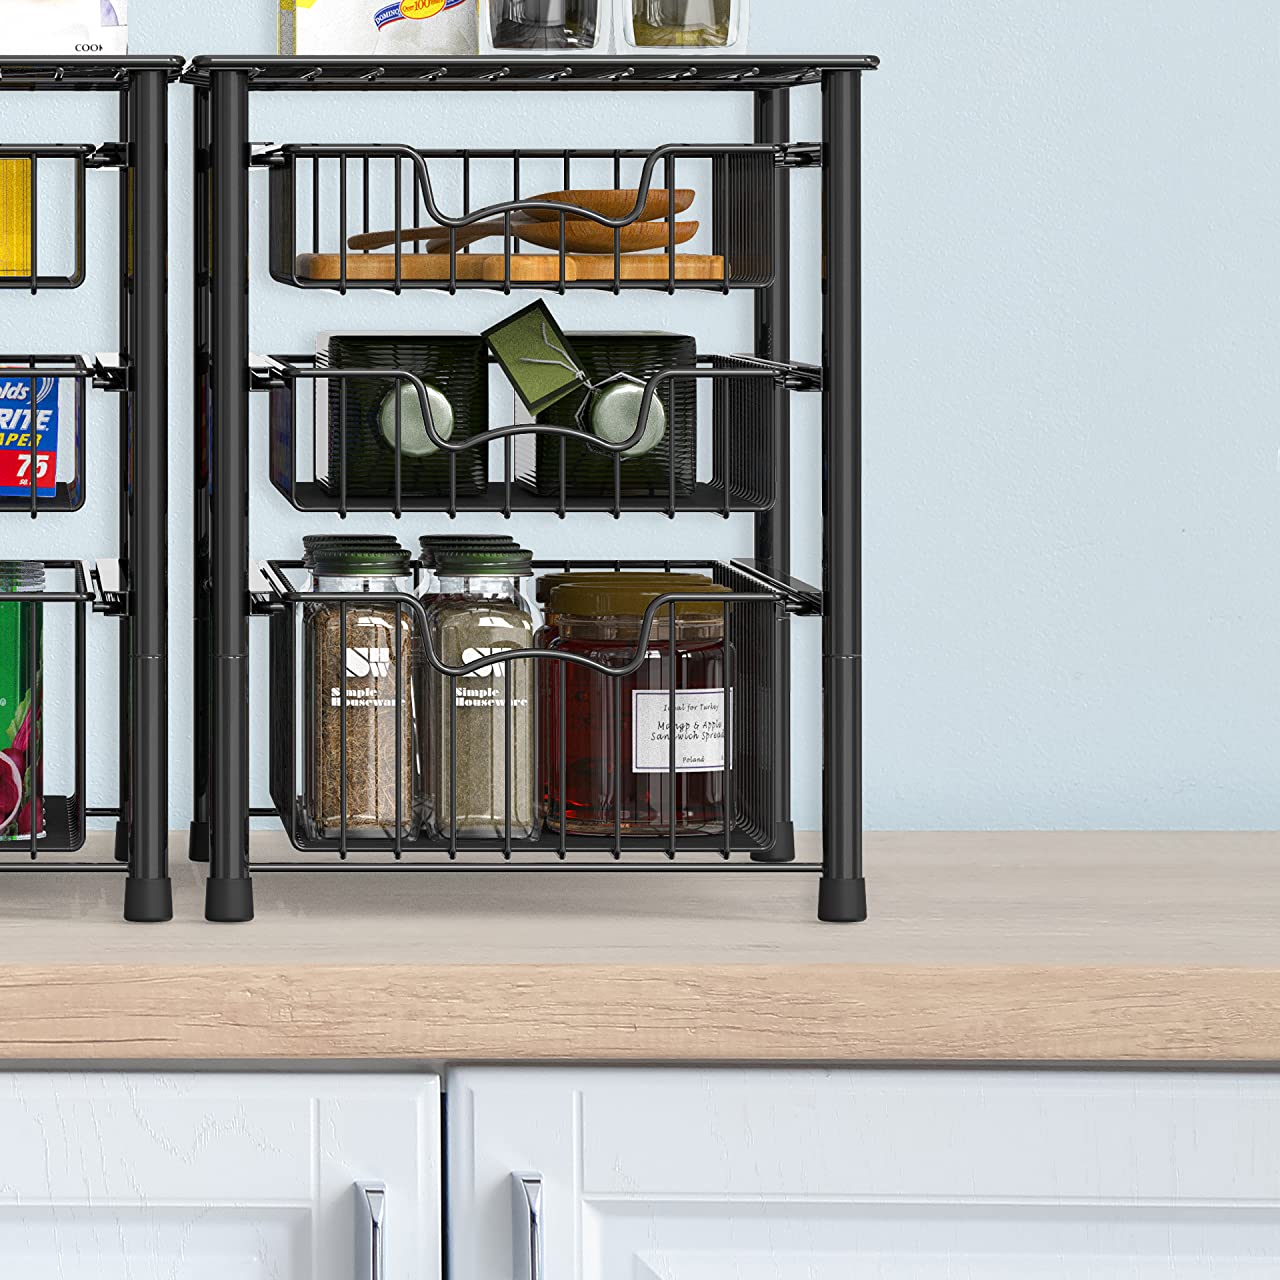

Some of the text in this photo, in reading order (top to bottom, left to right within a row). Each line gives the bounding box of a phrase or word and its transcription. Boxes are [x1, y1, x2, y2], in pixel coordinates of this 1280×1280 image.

[375, 8, 401, 24] DOMINO
[16, 453, 50, 479] 75
[330, 687, 378, 699] Smple
[455, 687, 500, 698] Simple
[455, 697, 528, 707] Housewre
[663, 703, 685, 712] Ial
[686, 703, 698, 712] for
[651, 731, 699, 741] Sanwich
